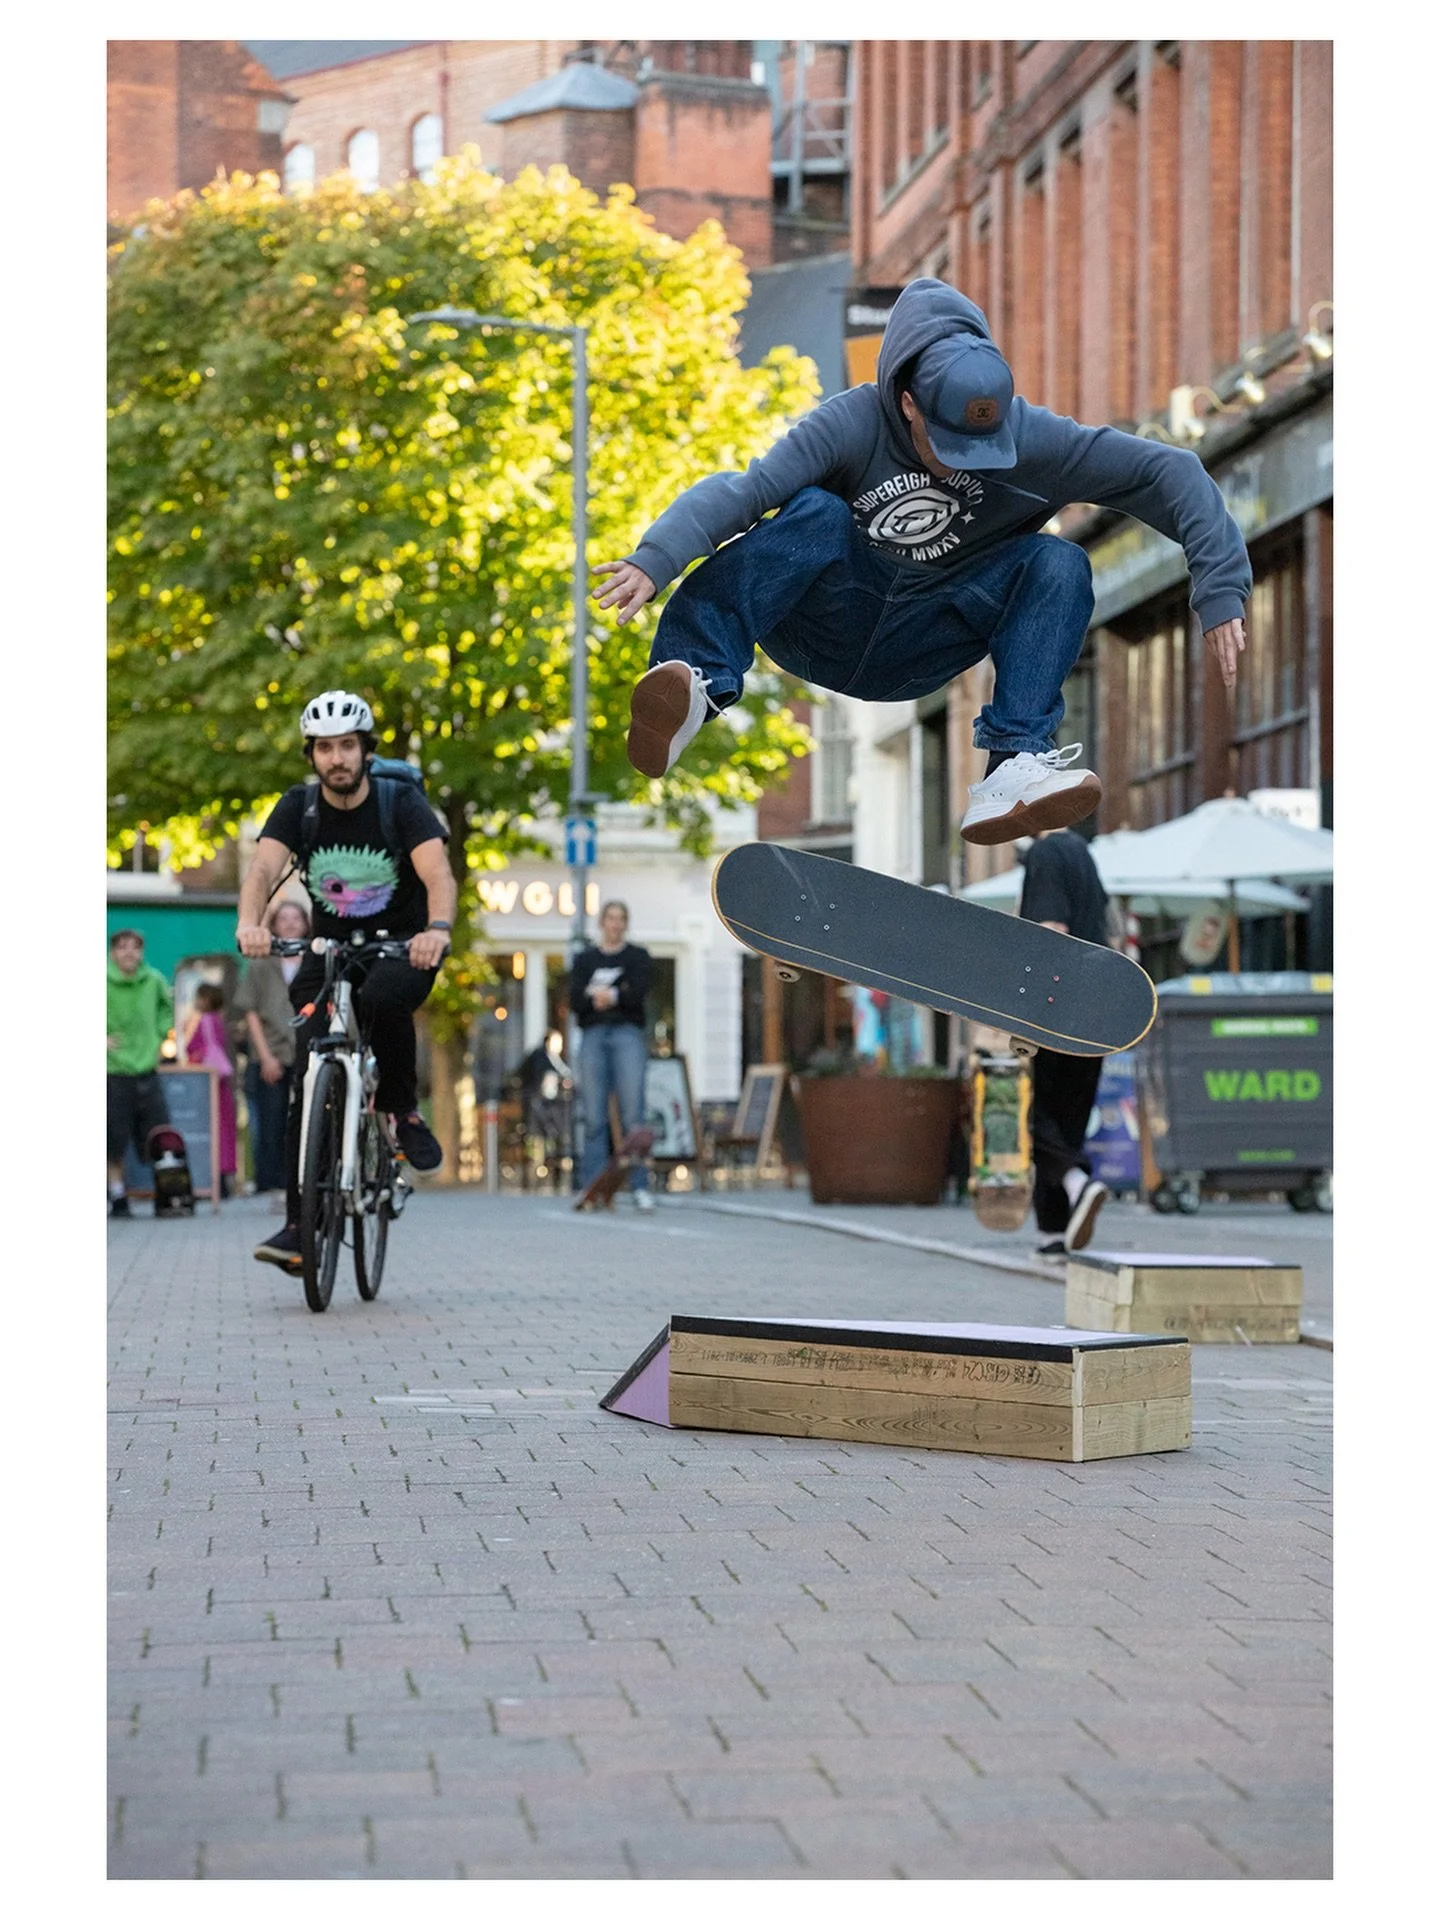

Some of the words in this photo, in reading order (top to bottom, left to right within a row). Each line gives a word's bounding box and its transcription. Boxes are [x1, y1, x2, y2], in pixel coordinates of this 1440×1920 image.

[852, 472, 931, 513] SUPEREIGH
[911, 531, 961, 561] MMXV
[1203, 1069, 1322, 1102] WARD
